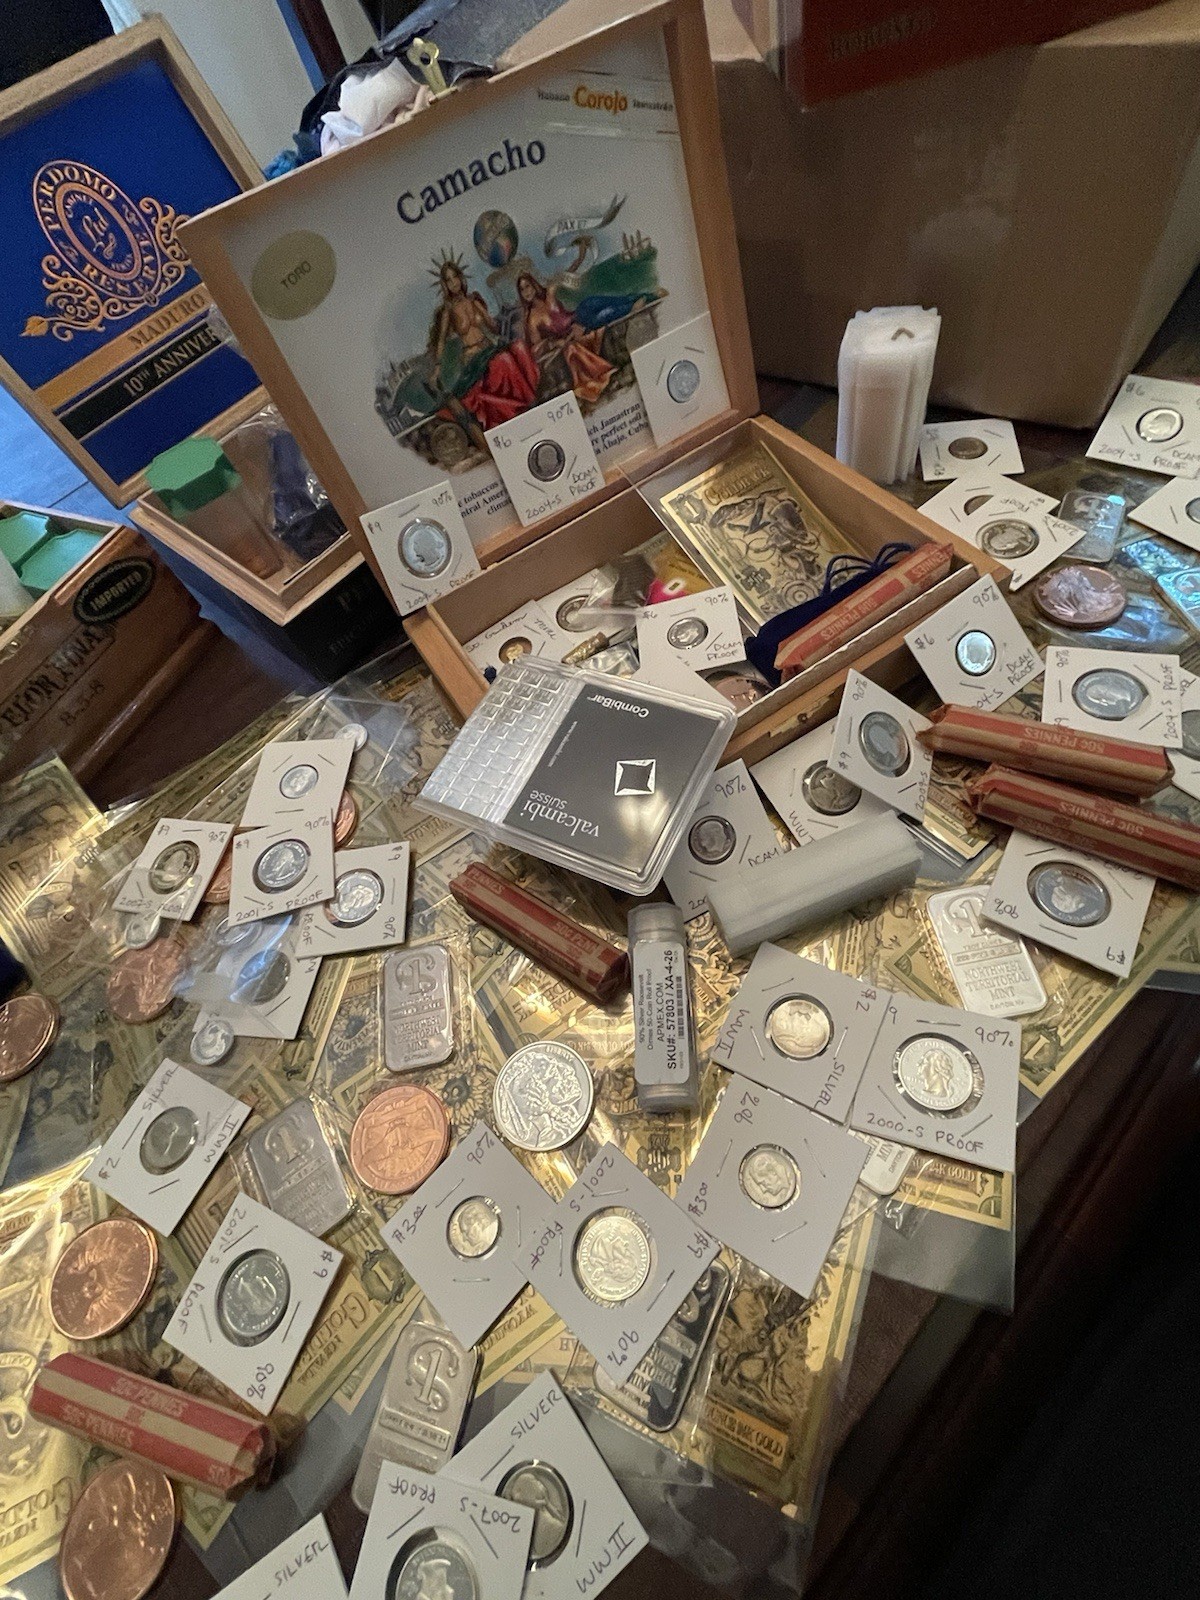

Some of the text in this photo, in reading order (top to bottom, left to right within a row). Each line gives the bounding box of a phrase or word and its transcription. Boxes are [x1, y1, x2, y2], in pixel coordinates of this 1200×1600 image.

[573, 84, 629, 115] Corojo
[397, 138, 547, 224] Camacho
[40, 165, 117, 231] PERDOMO
[83, 232, 157, 295] RESERVE
[280, 260, 313, 290] TORO
[127, 292, 207, 350] MADURO
[547, 402, 575, 422] 90%
[464, 480, 500, 502] tobaccos
[525, 480, 598, 519] 2004-S PROOF
[460, 500, 482, 520] ntral
[90, 571, 143, 611] IMPORTED
[704, 593, 729, 607] 90%
[972, 586, 1000, 608] 90%
[594, 693, 650, 720] CombiBar
[1024, 726, 1082, 748] PENNIES
[529, 789, 568, 810] suisse
[714, 774, 748, 800] 90%
[305, 815, 331, 831] 90%
[519, 800, 600, 838] valcambi
[1057, 800, 1113, 827] PENNIES
[236, 888, 323, 921] 2001-S PROOF
[993, 897, 1019, 920] 90%
[664, 949, 675, 990] XA-4-26
[963, 959, 1022, 981] NORTHWEST
[965, 971, 1030, 993] TERRITORIAL
[637, 973, 645, 1005] Roosevelt
[990, 986, 1016, 1001] MINT
[656, 982, 665, 1043] APMEX.COM
[667, 998, 676, 1032] 57803
[889, 1006, 899, 1025] 9
[666, 1033, 678, 1070] SKU#:
[975, 1027, 1014, 1048] 90%
[813, 1060, 846, 1109] SILVER
[733, 1090, 761, 1126] 90%
[467, 1131, 496, 1166] 90%
[866, 1112, 984, 1154] 2000-S PROOF
[569, 1156, 615, 1214] 2001-S
[529, 1220, 564, 1271] PROOF
[606, 1329, 641, 1367] 90%
[246, 1362, 275, 1399] 90%
[510, 1389, 562, 1439] SILVER
[755, 1430, 783, 1456] GOLD
[389, 1476, 436, 1504] PROOF
[459, 1496, 521, 1534] 2007-S
[274, 1540, 330, 1587] SILVER
[575, 1521, 636, 1594] WWII
